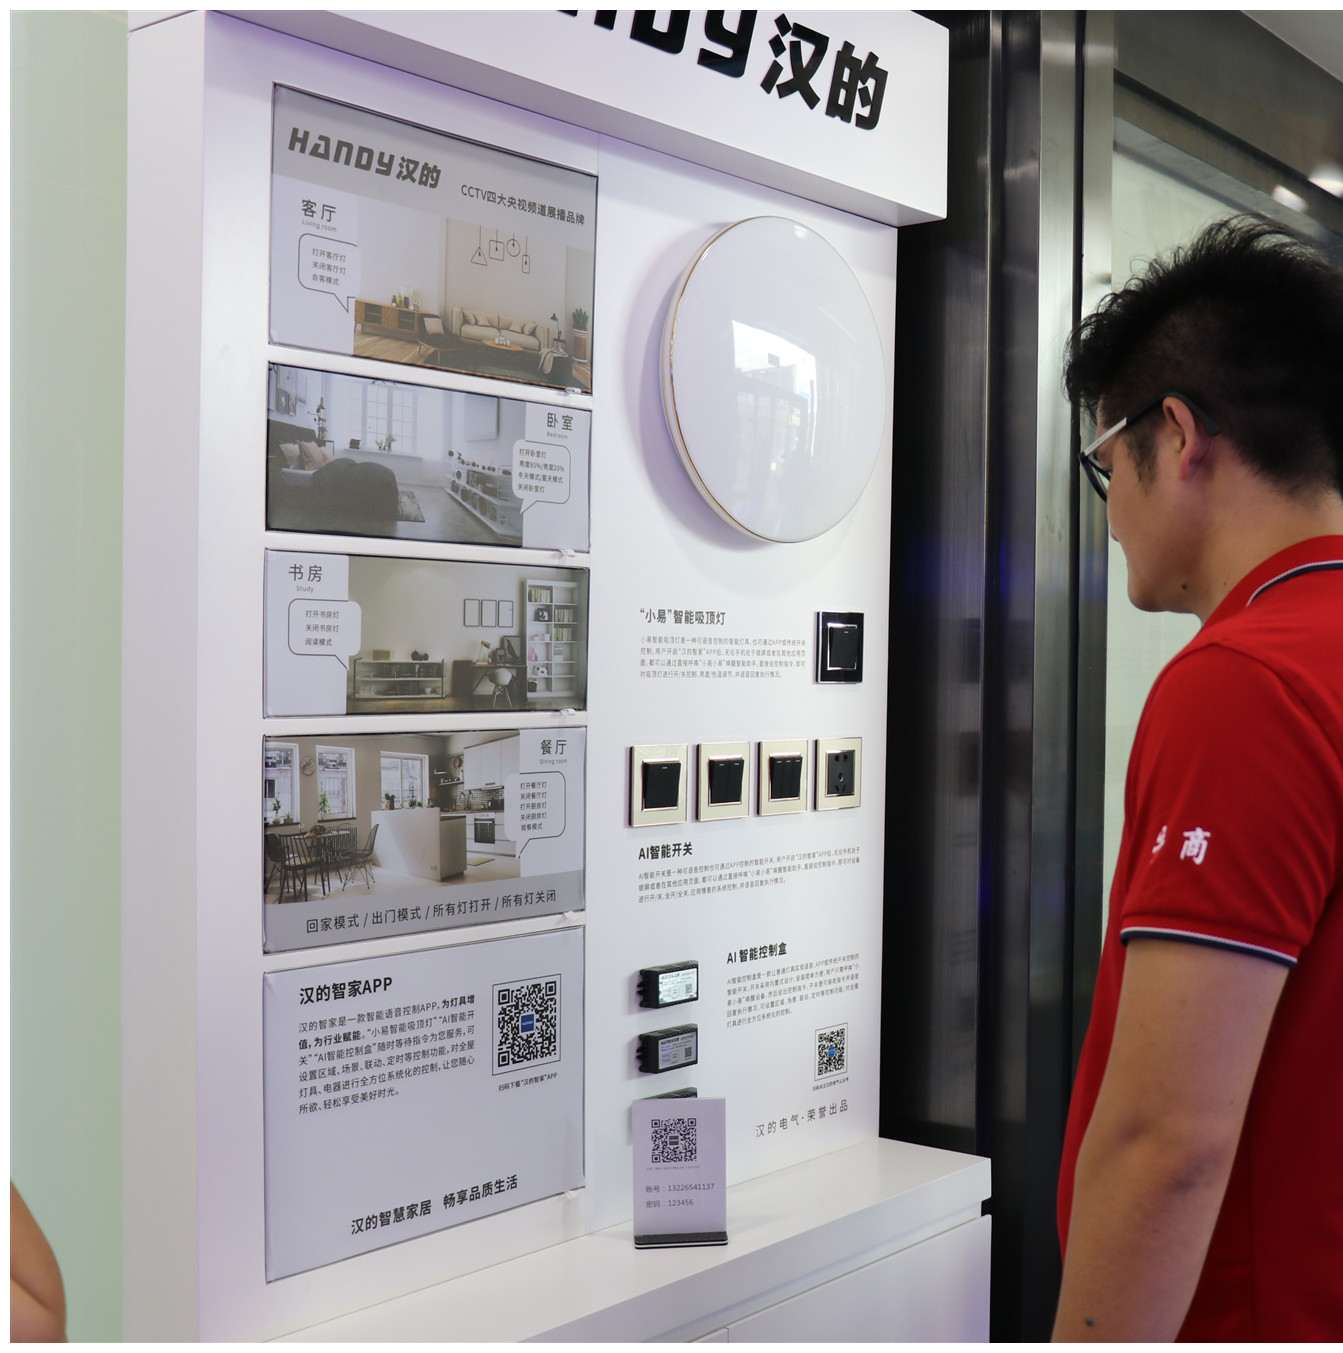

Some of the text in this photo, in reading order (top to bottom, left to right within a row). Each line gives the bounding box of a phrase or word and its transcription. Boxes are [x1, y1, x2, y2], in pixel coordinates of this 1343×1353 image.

[301, 199, 336, 222] 客厅
[461, 184, 585, 226] CCTV四大央视频道展播品牌
[301, 219, 320, 229] Living
[312, 248, 346, 262] 打开客厅灯
[312, 261, 346, 275] 关闭客厅灯
[312, 273, 340, 286] 会客模式
[547, 412, 573, 431] 卧室
[519, 448, 546, 459] 打开卧室灯
[518, 483, 545, 493] 关闭卧室灯
[288, 563, 322, 582] 书房
[296, 585, 314, 593] Study
[305, 610, 339, 619] 打开书房灯
[305, 624, 339, 632] 关闭书房灯
[305, 637, 332, 646] 阅读模式
[541, 739, 567, 755] 餐厅
[520, 781, 547, 790] 打开餐厅灯
[520, 792, 547, 800] 关闭餐厅灯
[520, 802, 547, 811] 打开厨房灯
[638, 841, 693, 860] AI智能开关
[299, 976, 393, 1005] 汉的智家APP
[351, 1174, 518, 1235] 汉的智慧家居 畅享品质生活
